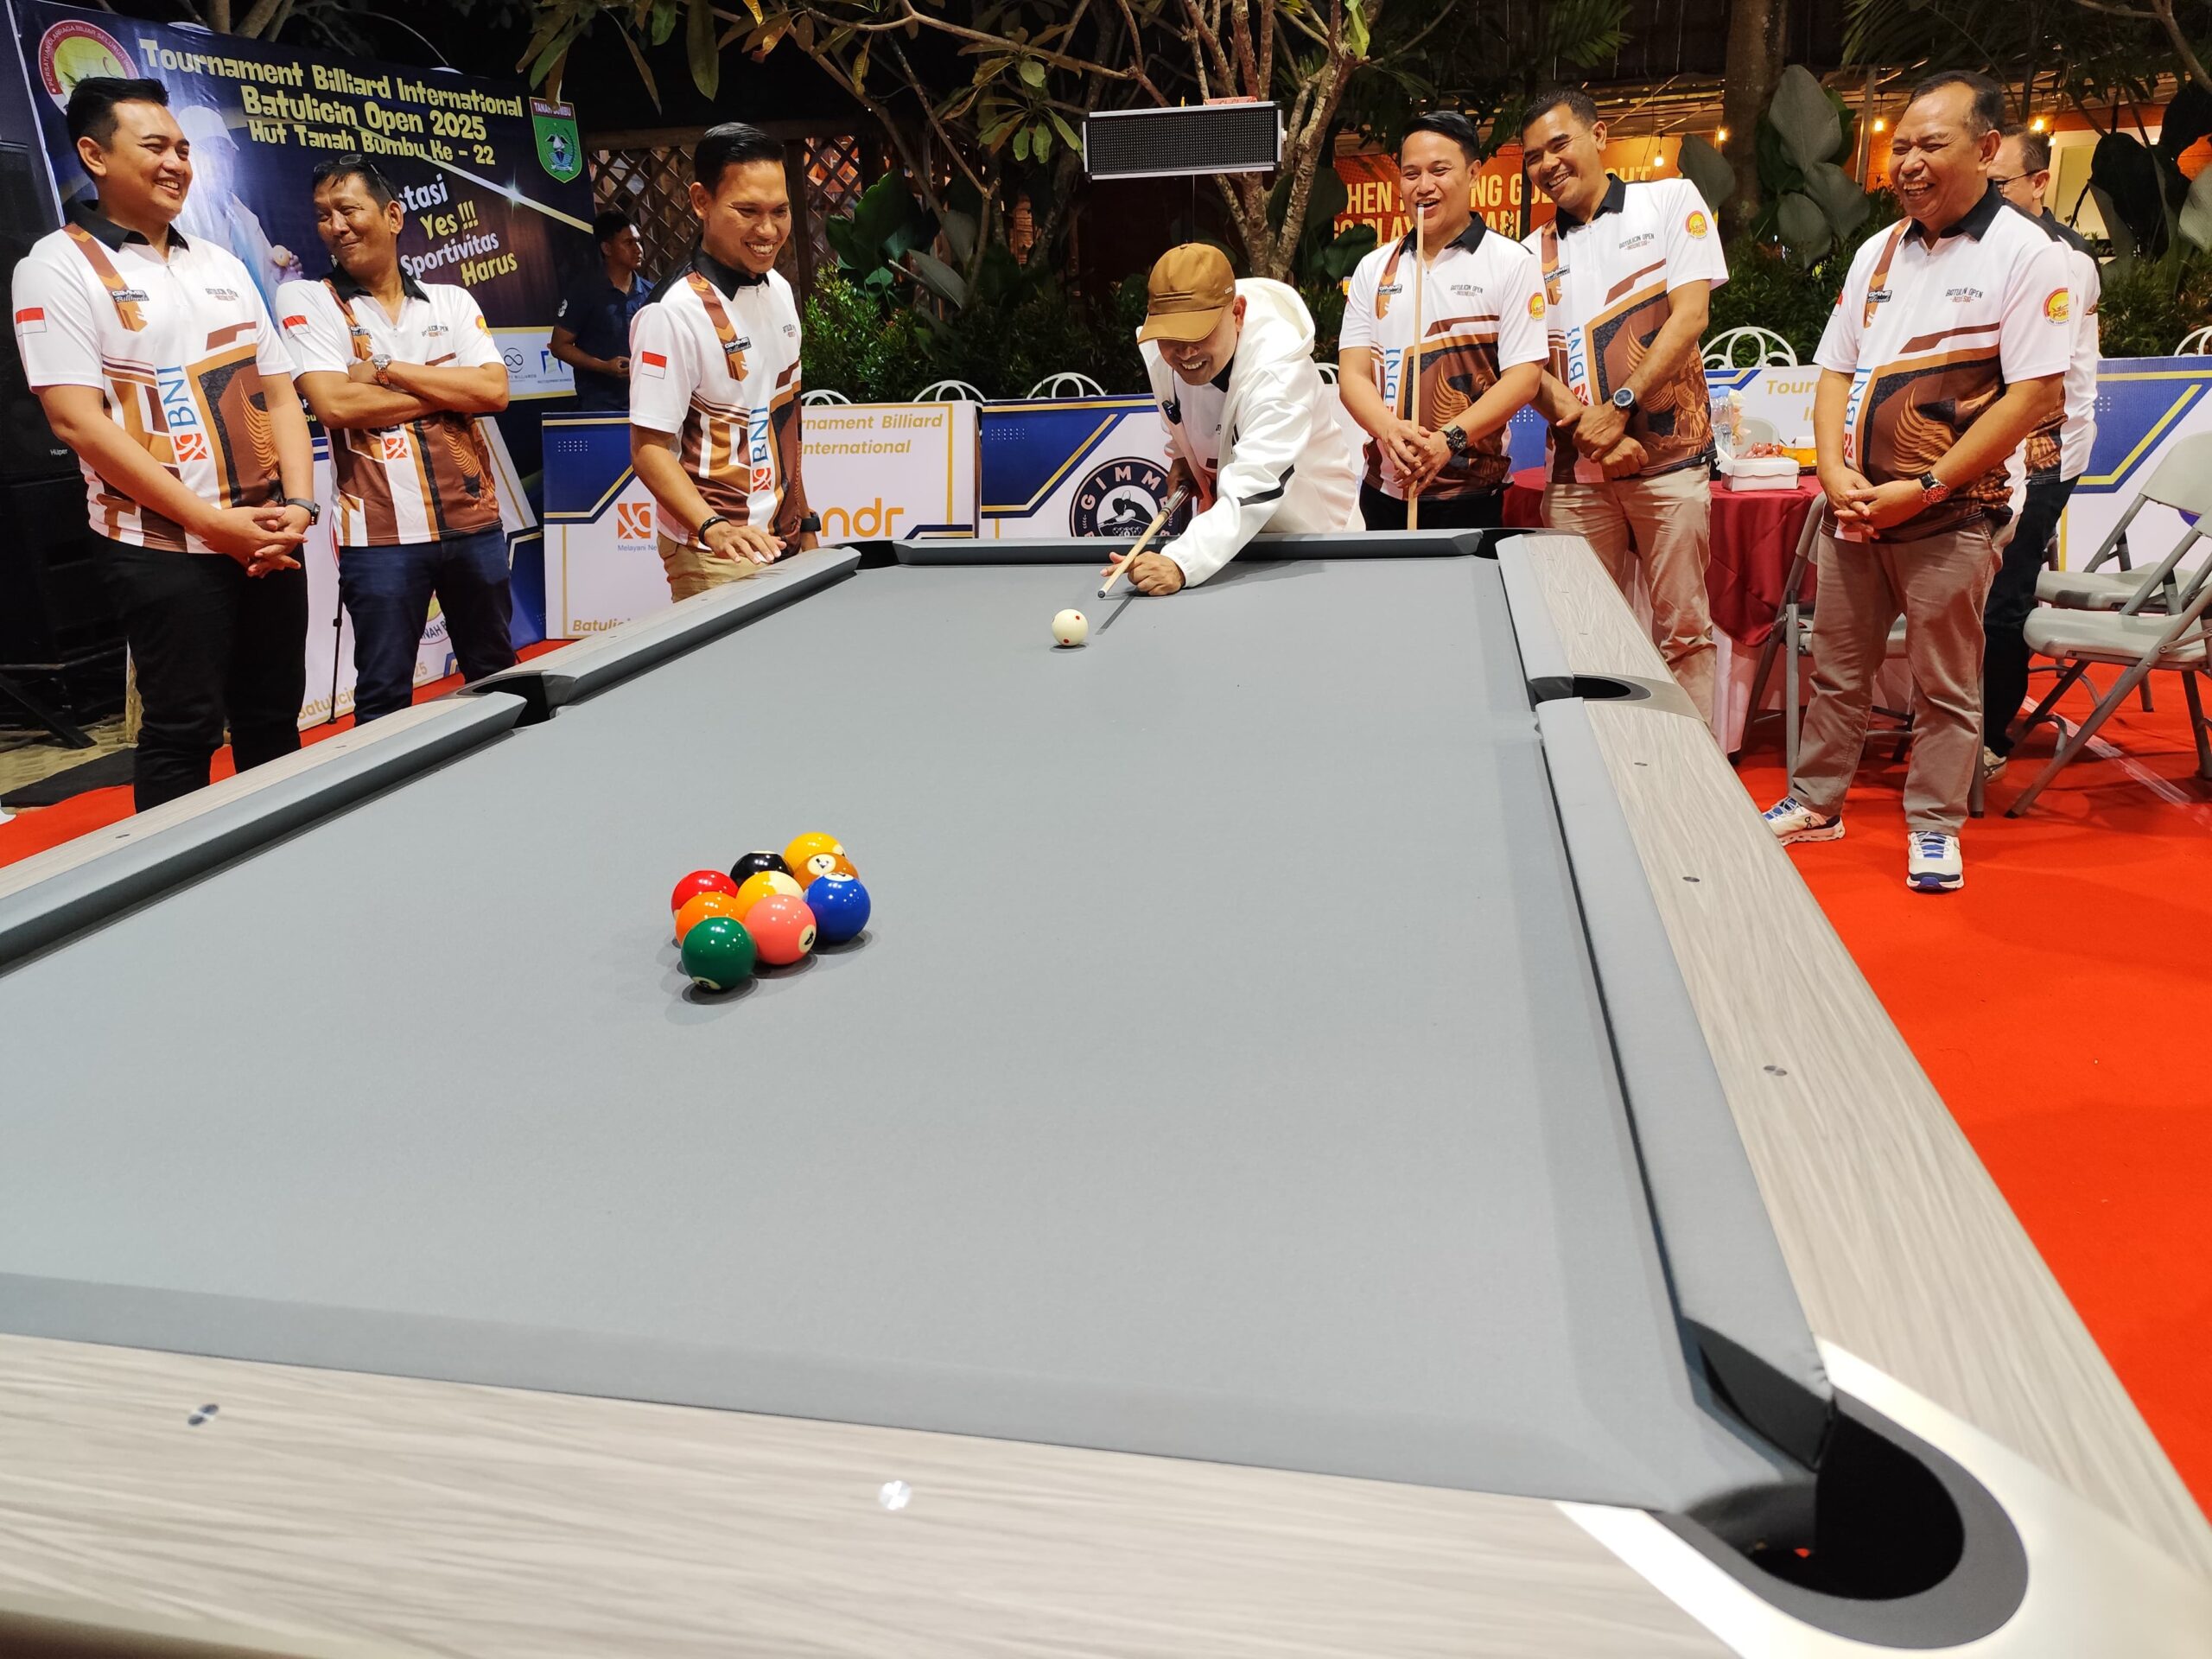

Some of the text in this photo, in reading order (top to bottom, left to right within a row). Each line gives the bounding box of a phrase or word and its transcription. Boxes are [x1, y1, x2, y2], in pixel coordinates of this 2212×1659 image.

[139, 39, 523, 118] Tournament Billiard International
[240, 85, 486, 141] Batulicin Open 2025
[247, 119, 287, 144] Hut
[294, 124, 356, 151] Tanah
[360, 131, 425, 157] Bumbu
[429, 139, 454, 162] Ke
[473, 145, 496, 166] 22
[419, 200, 479, 240] Yes !!!
[400, 232, 499, 279] Sportivitas
[460, 251, 518, 288] Harus
[156, 365, 198, 429] BNI
[1766, 380, 1818, 395] Tour
[749, 406, 769, 462] BNI
[881, 414, 943, 429] Billiard
[802, 440, 912, 454] nternational
[810, 498, 904, 537] ndr
